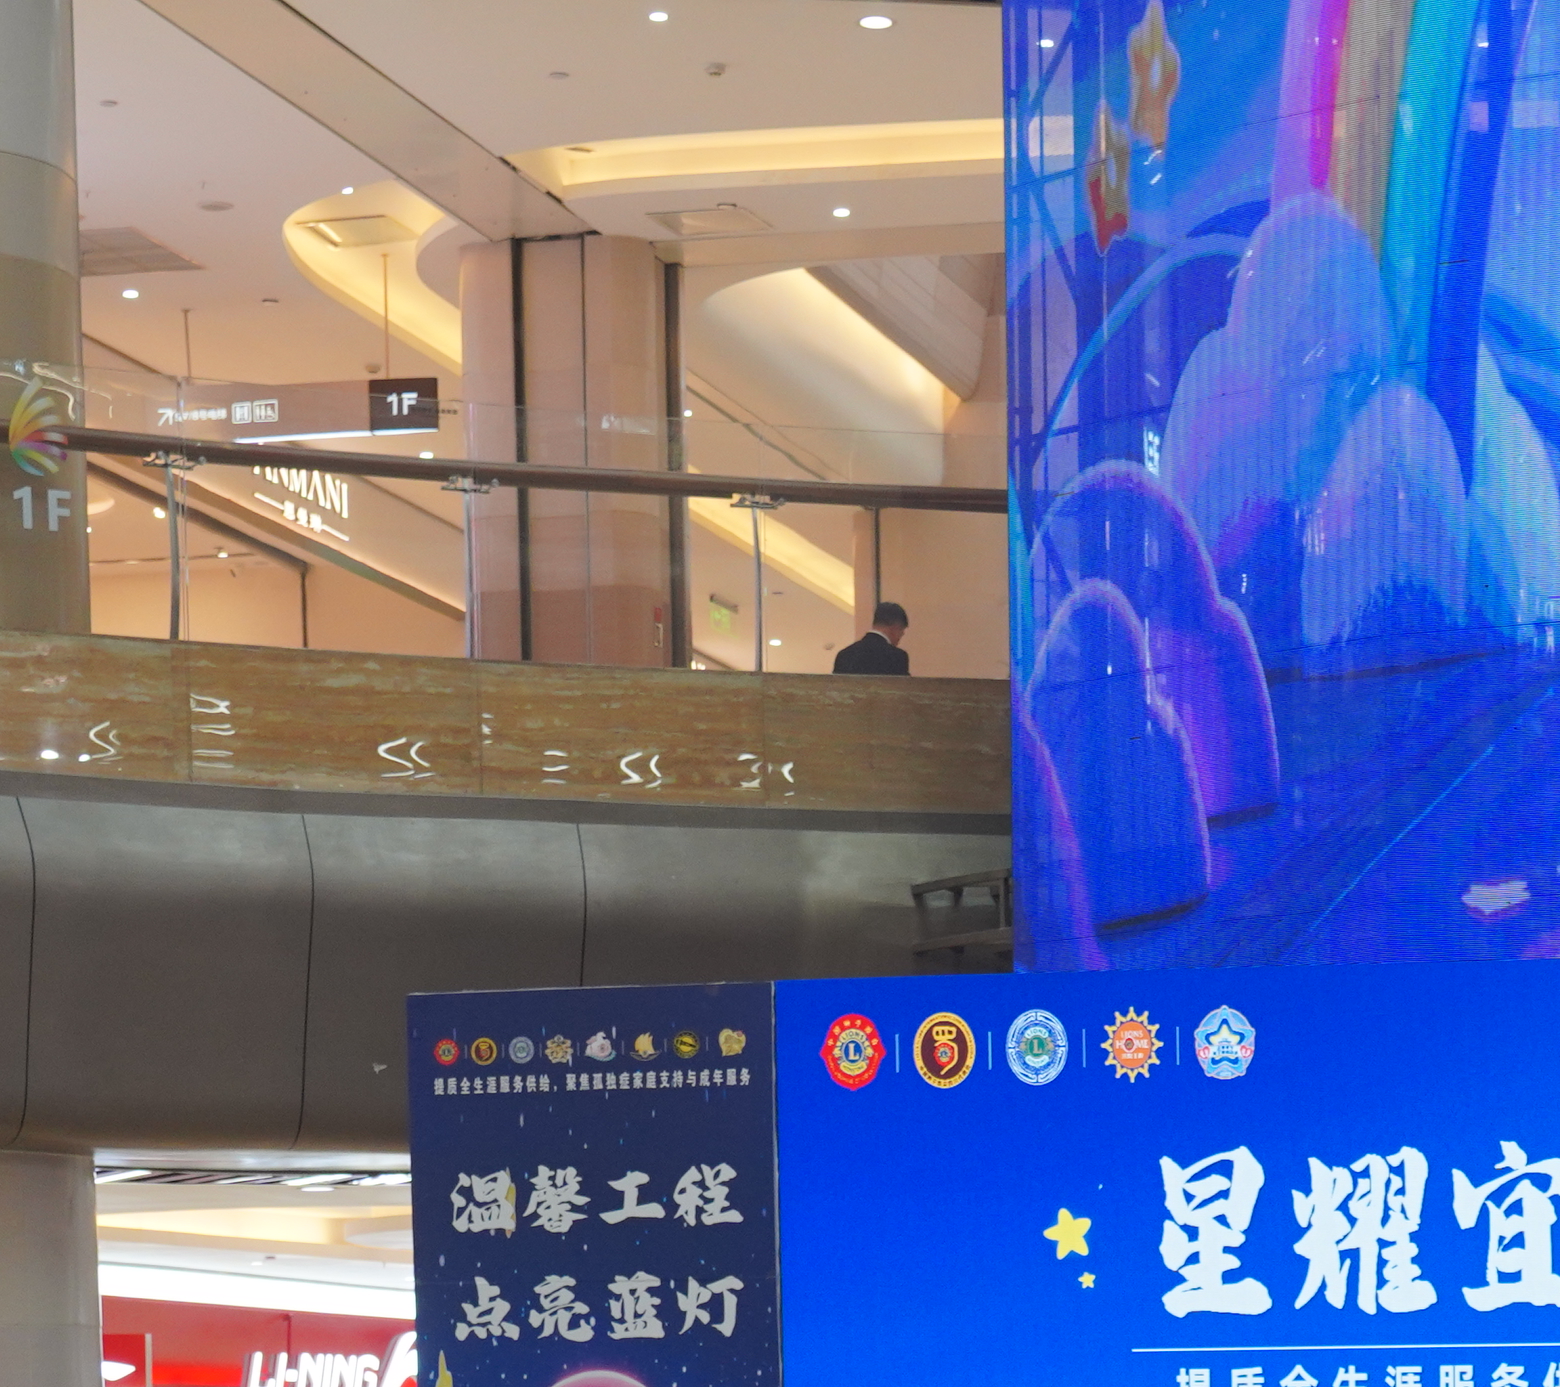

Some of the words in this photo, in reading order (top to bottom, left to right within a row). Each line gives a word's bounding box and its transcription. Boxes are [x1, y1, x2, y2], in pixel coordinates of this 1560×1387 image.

[386, 392, 418, 415] 1F
[13, 486, 72, 532] 1F
[253, 465, 348, 518] NMANI
[451, 1162, 744, 1235] 温馨工程
[454, 1274, 745, 1343] 点亮蓝灯
